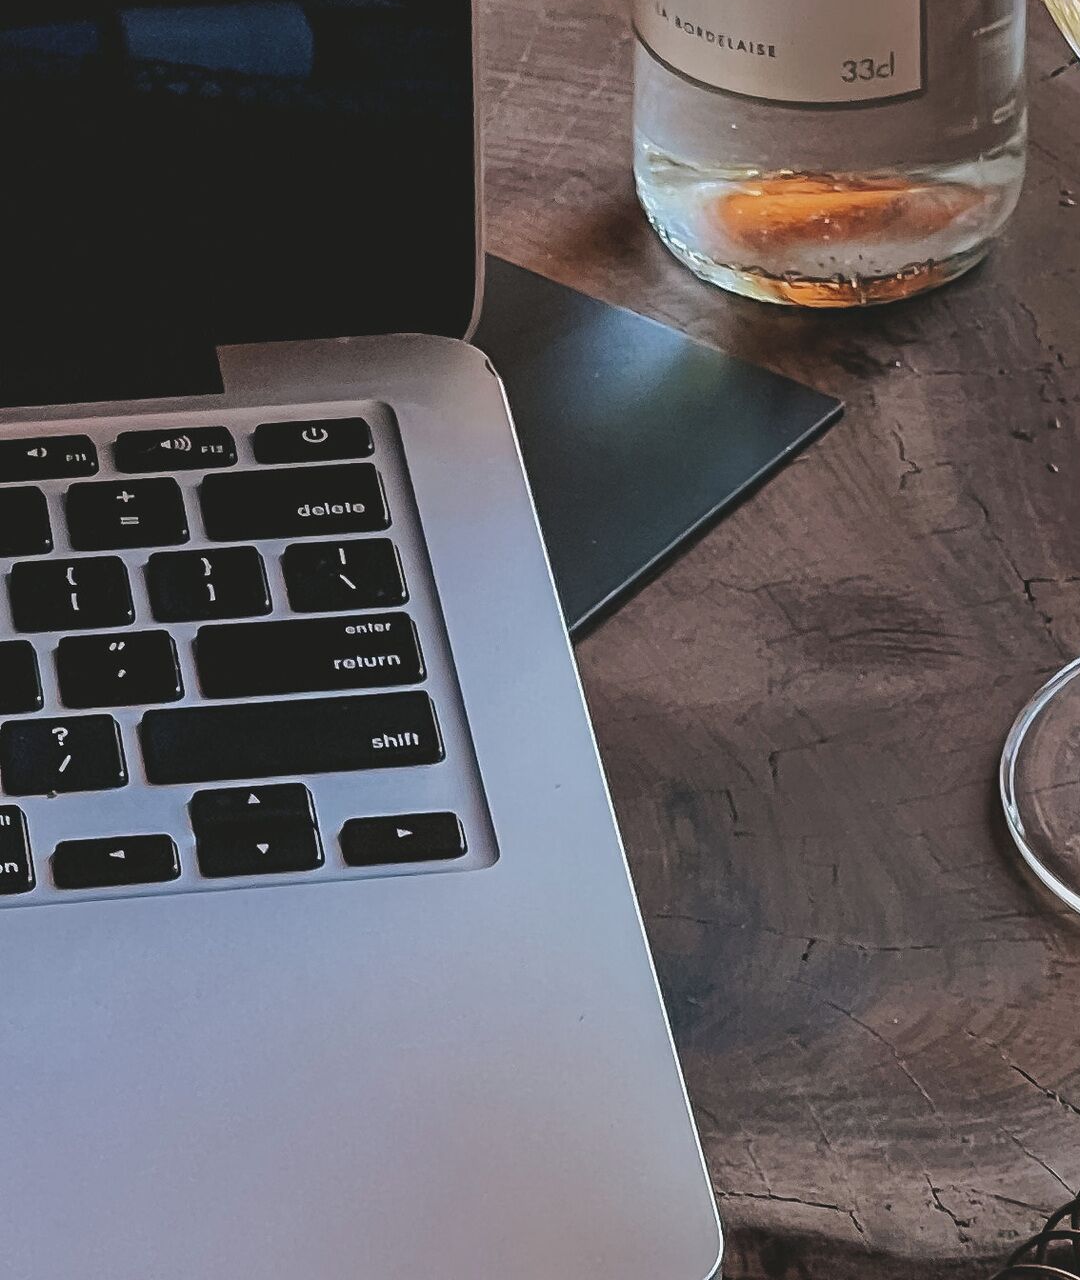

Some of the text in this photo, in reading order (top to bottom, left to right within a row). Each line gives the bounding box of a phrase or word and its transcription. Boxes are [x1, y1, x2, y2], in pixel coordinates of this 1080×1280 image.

[674, 15, 777, 58] BORDELAISE
[840, 50, 895, 83] 33cl
[297, 502, 366, 517] delete
[345, 622, 392, 635] enter
[333, 654, 401, 670] return
[51, 726, 69, 747] ?
[371, 732, 419, 749] shift
